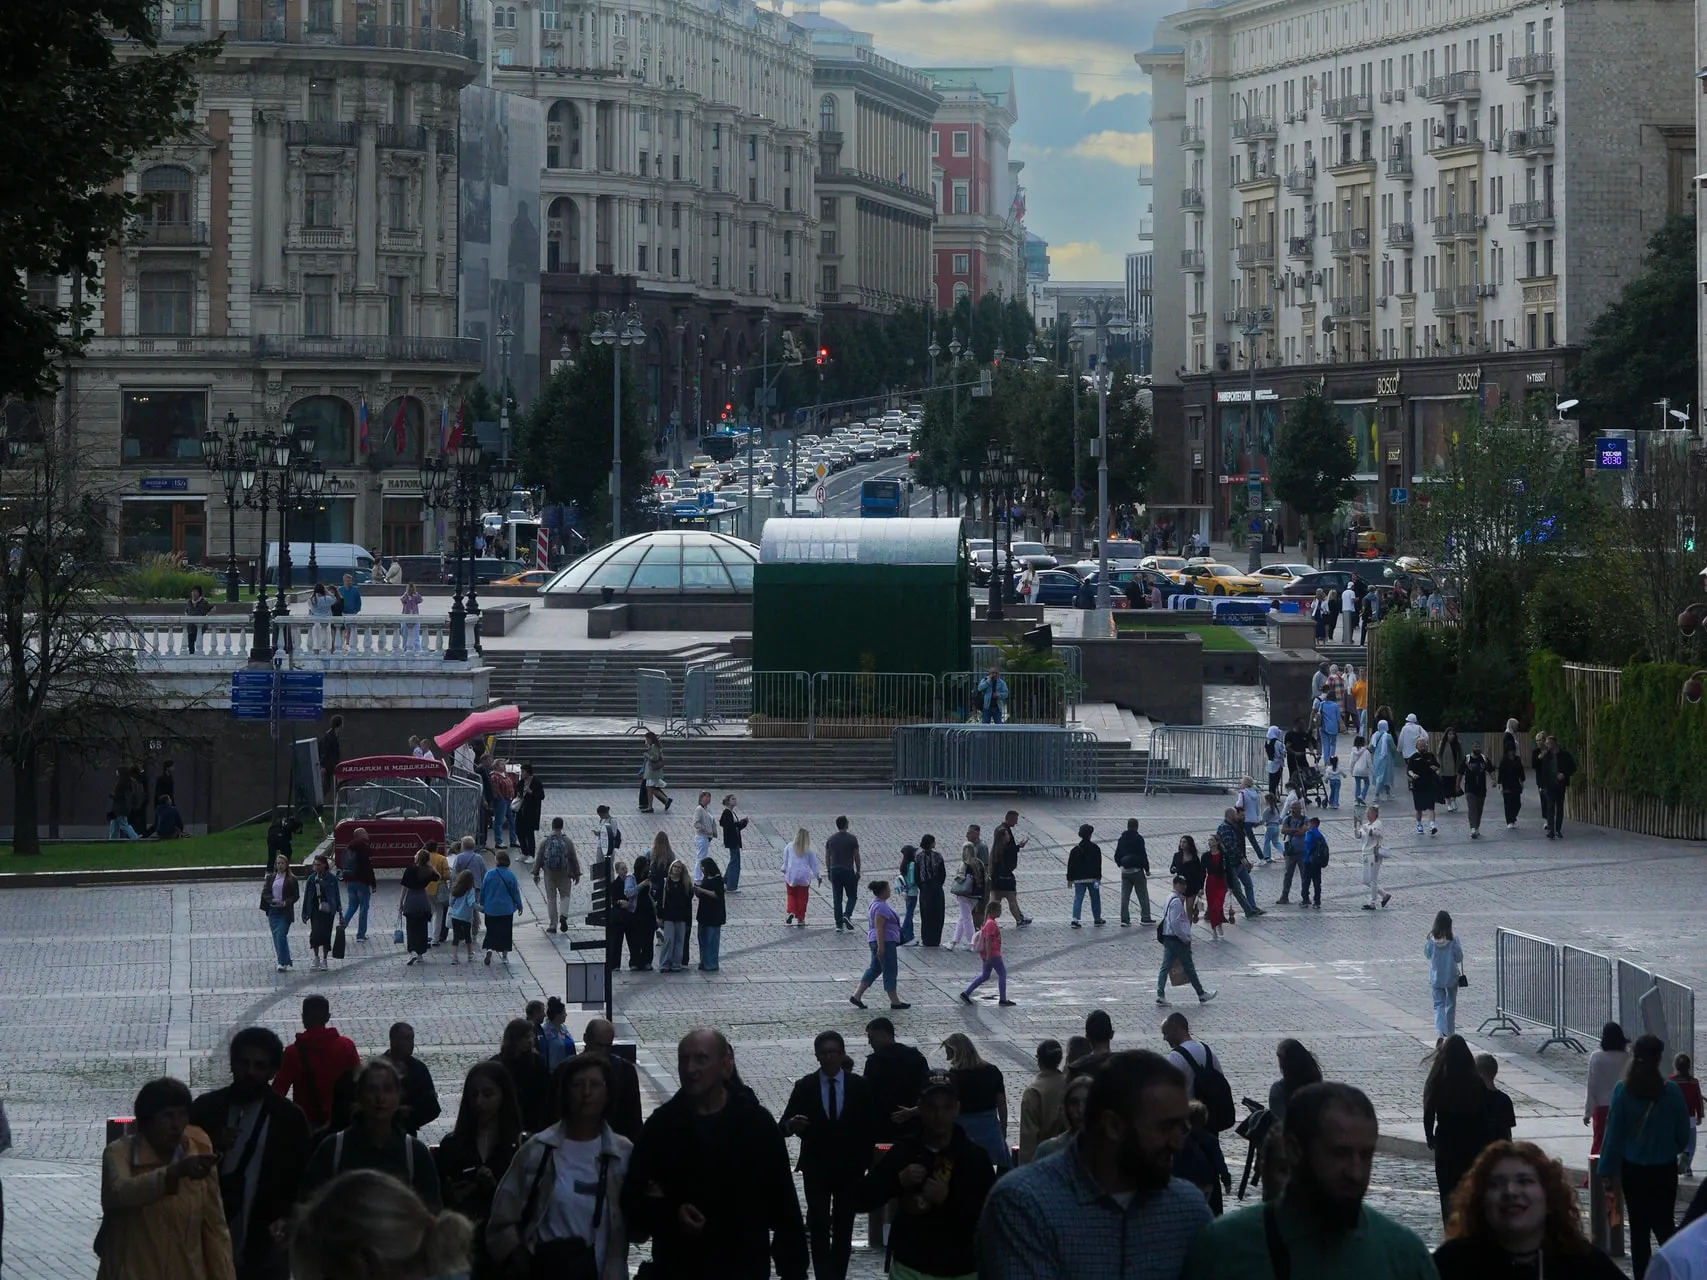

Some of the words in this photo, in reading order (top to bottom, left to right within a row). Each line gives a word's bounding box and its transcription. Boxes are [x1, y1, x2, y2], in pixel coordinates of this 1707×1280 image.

[1377, 377, 1398, 394] BOSCO
[1457, 373, 1479, 391] BOSCO
[1602, 456, 1622, 465] 2030
